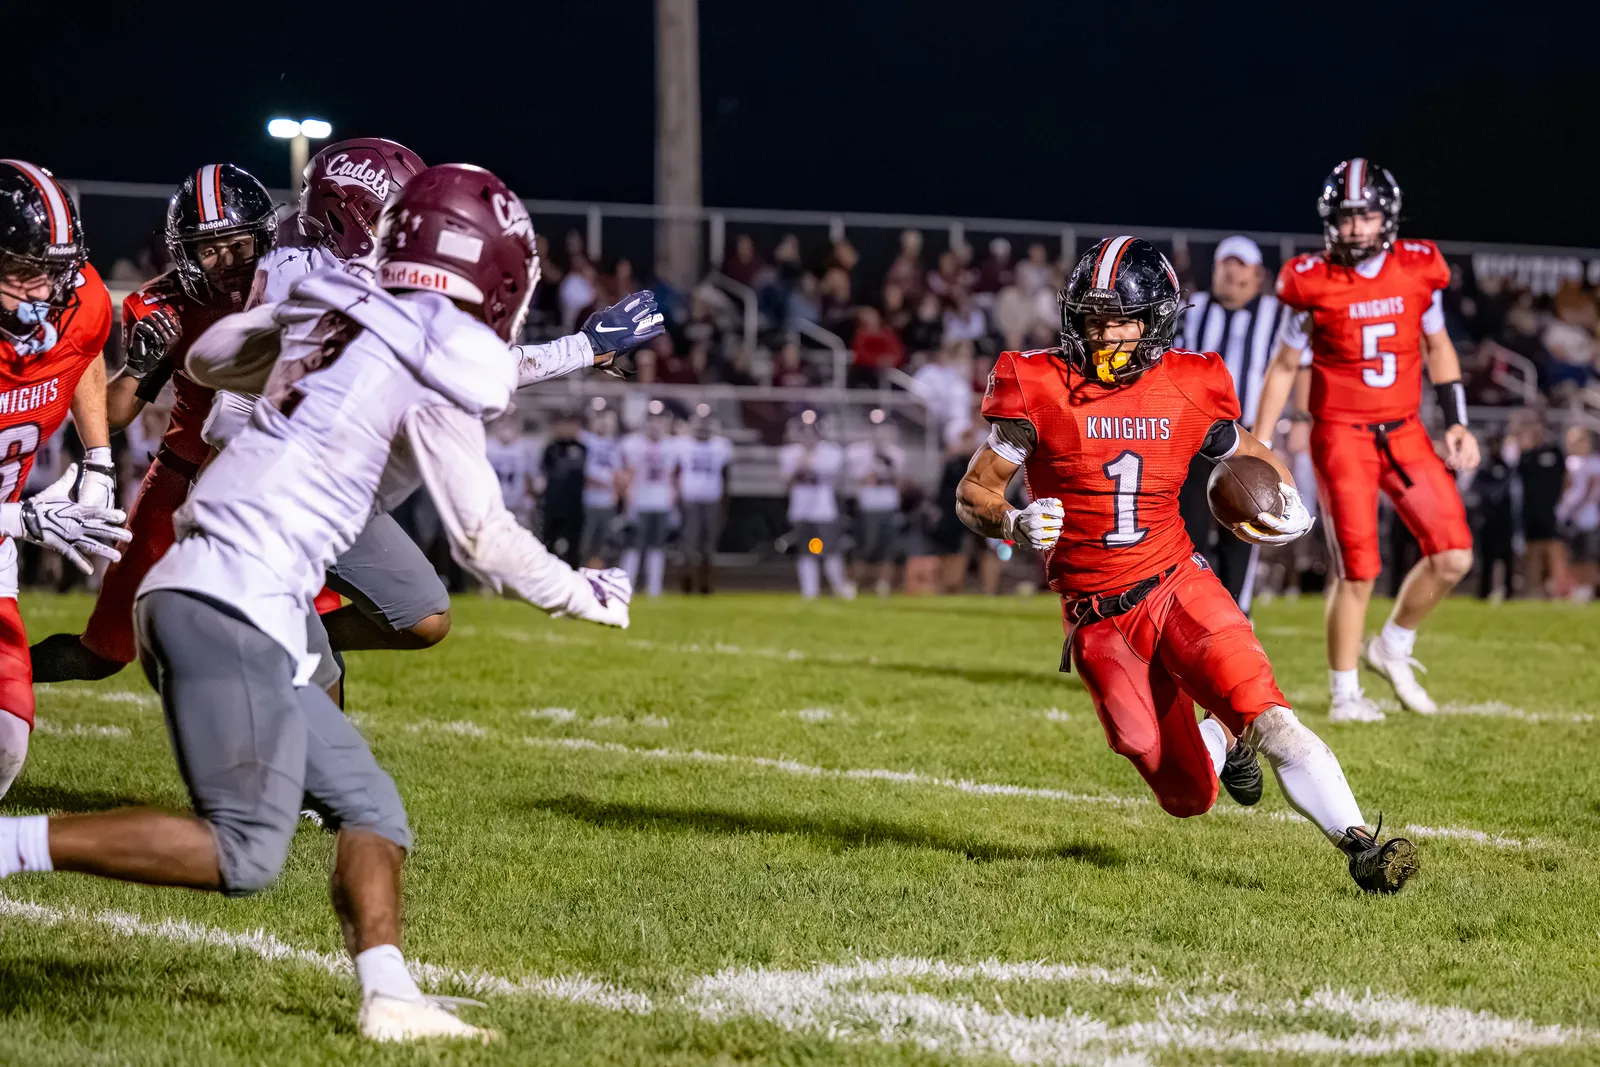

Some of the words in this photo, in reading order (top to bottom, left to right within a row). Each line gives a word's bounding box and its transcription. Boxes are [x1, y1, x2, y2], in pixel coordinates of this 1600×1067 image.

[326, 154, 390, 201] Cadets
[199, 218, 229, 230] Riddell
[382, 267, 448, 290] Riddell
[1348, 296, 1404, 319] KNIGHTS
[1361, 321, 1398, 389] 5
[0, 377, 59, 414] NIGHTS
[1086, 416, 1171, 440] KNIGHTS
[1101, 449, 1151, 549] 1
